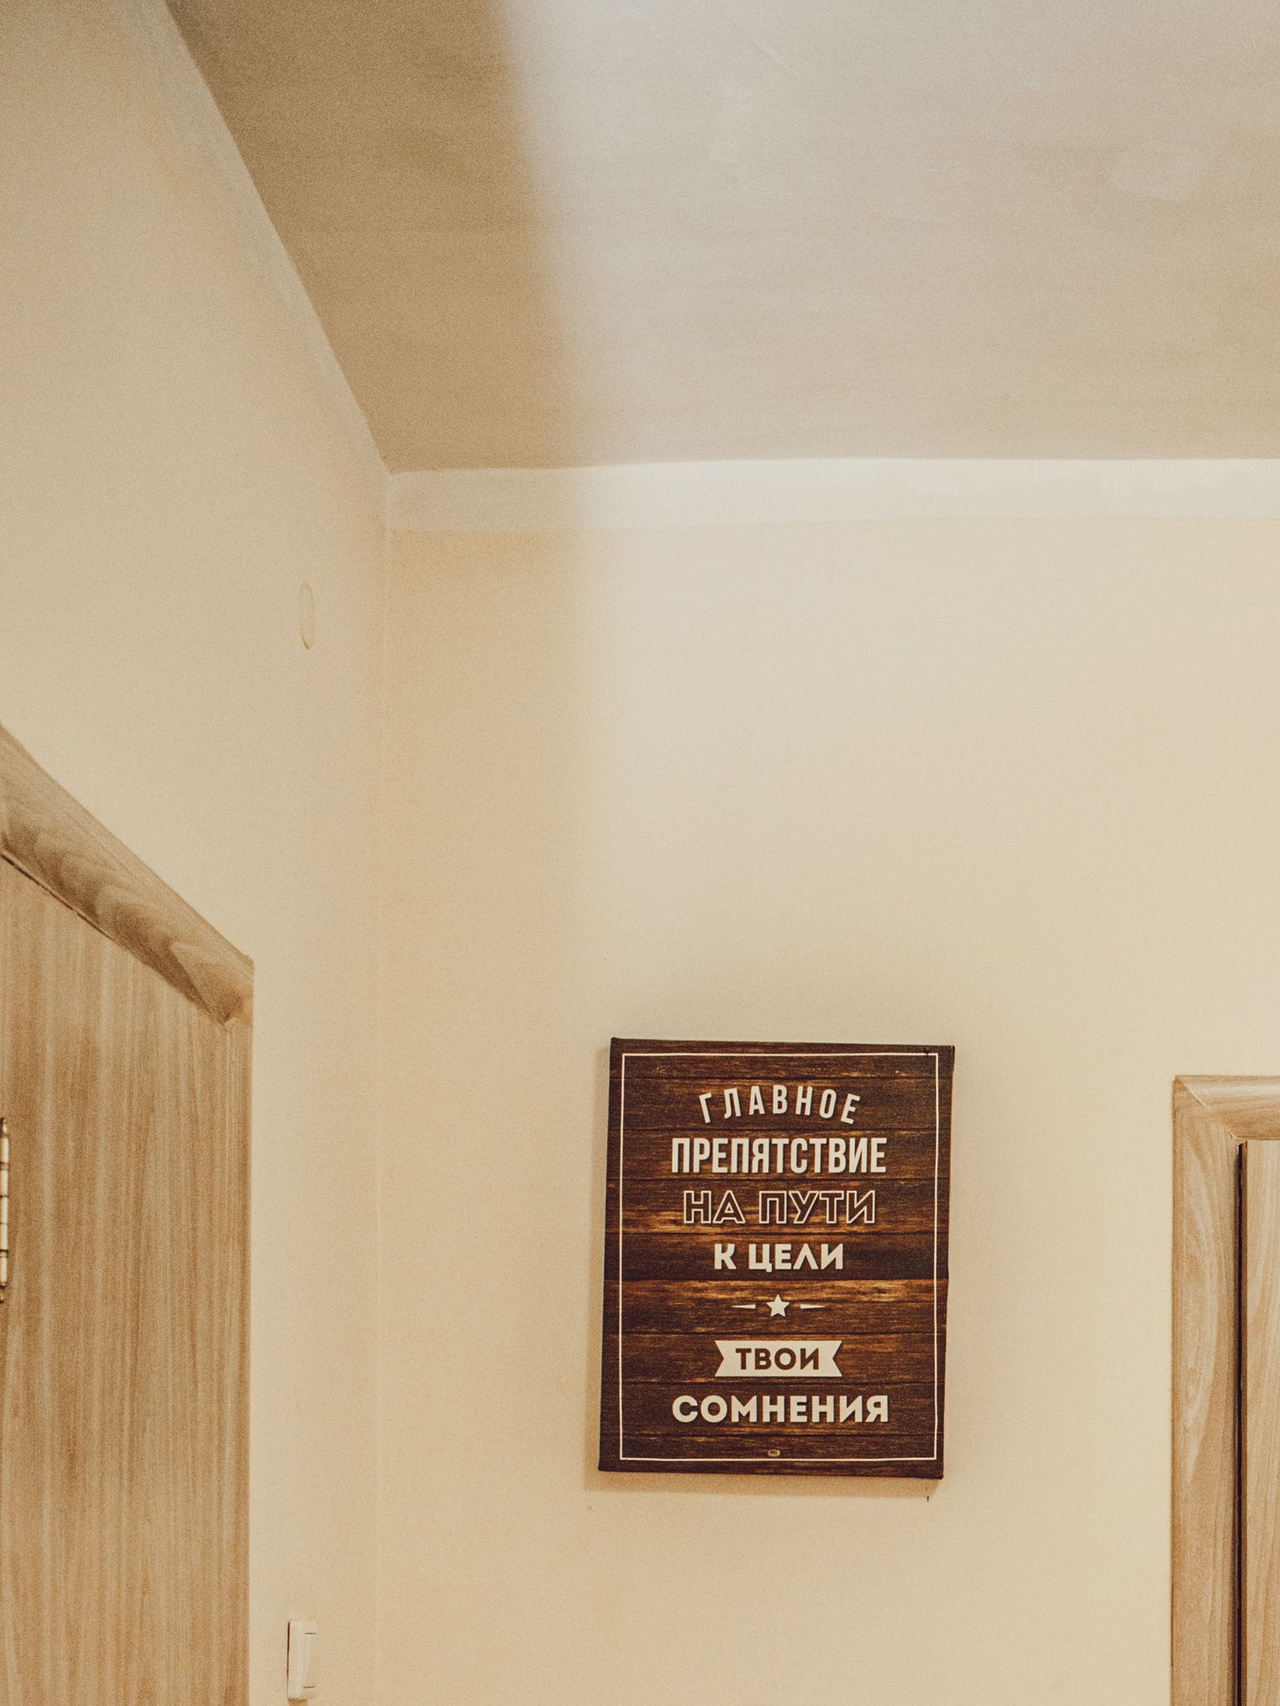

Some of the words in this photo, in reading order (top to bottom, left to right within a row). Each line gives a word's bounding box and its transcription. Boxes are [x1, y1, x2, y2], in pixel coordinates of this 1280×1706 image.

[699, 1084, 861, 1125] ГЛАВНОЕ
[671, 1137, 888, 1174] ПРЕПЯТСТВИЕ
[683, 1190, 745, 1224] НА
[758, 1190, 877, 1225] ПУТИ
[713, 1243, 737, 1270] К
[748, 1243, 844, 1272] ЦЕЛИ
[735, 1347, 820, 1371] ТВОИ
[671, 1395, 889, 1424] СОМНЕНИЯ
